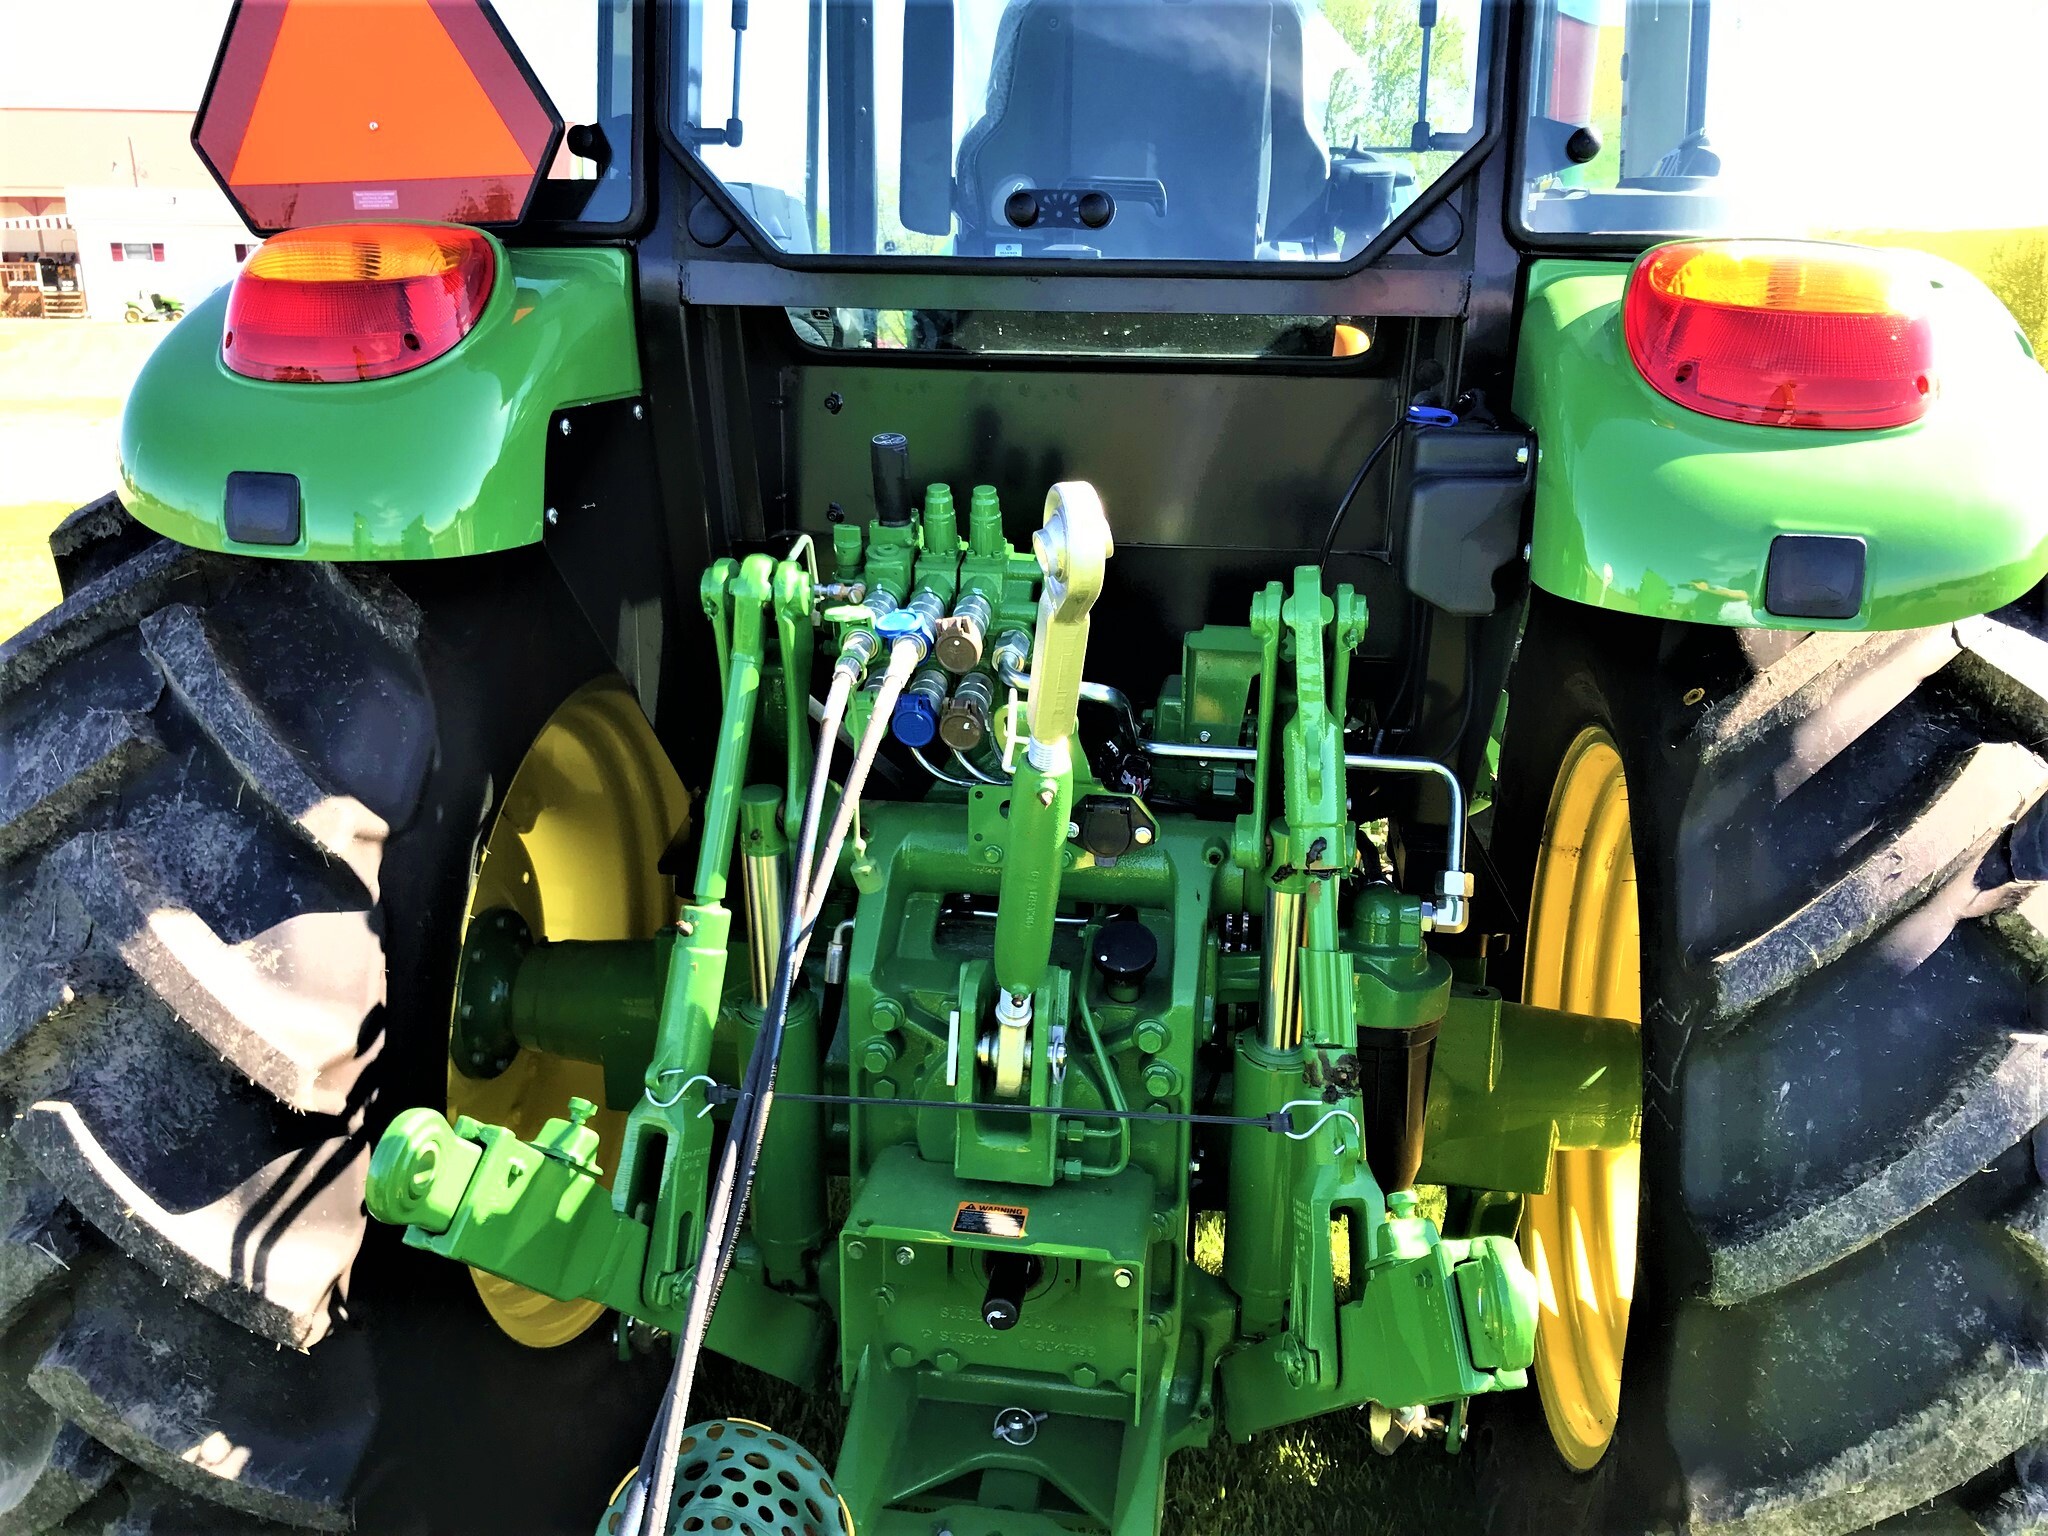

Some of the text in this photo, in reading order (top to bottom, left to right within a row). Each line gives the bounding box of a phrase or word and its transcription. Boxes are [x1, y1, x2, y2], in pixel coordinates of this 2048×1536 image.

[717, 1272, 727, 1287] SAE
[722, 1244, 735, 1272] 100R17
[732, 1227, 741, 1240] ISO
[742, 1184, 752, 1203] Type
[979, 1205, 1024, 1215] WARNING
